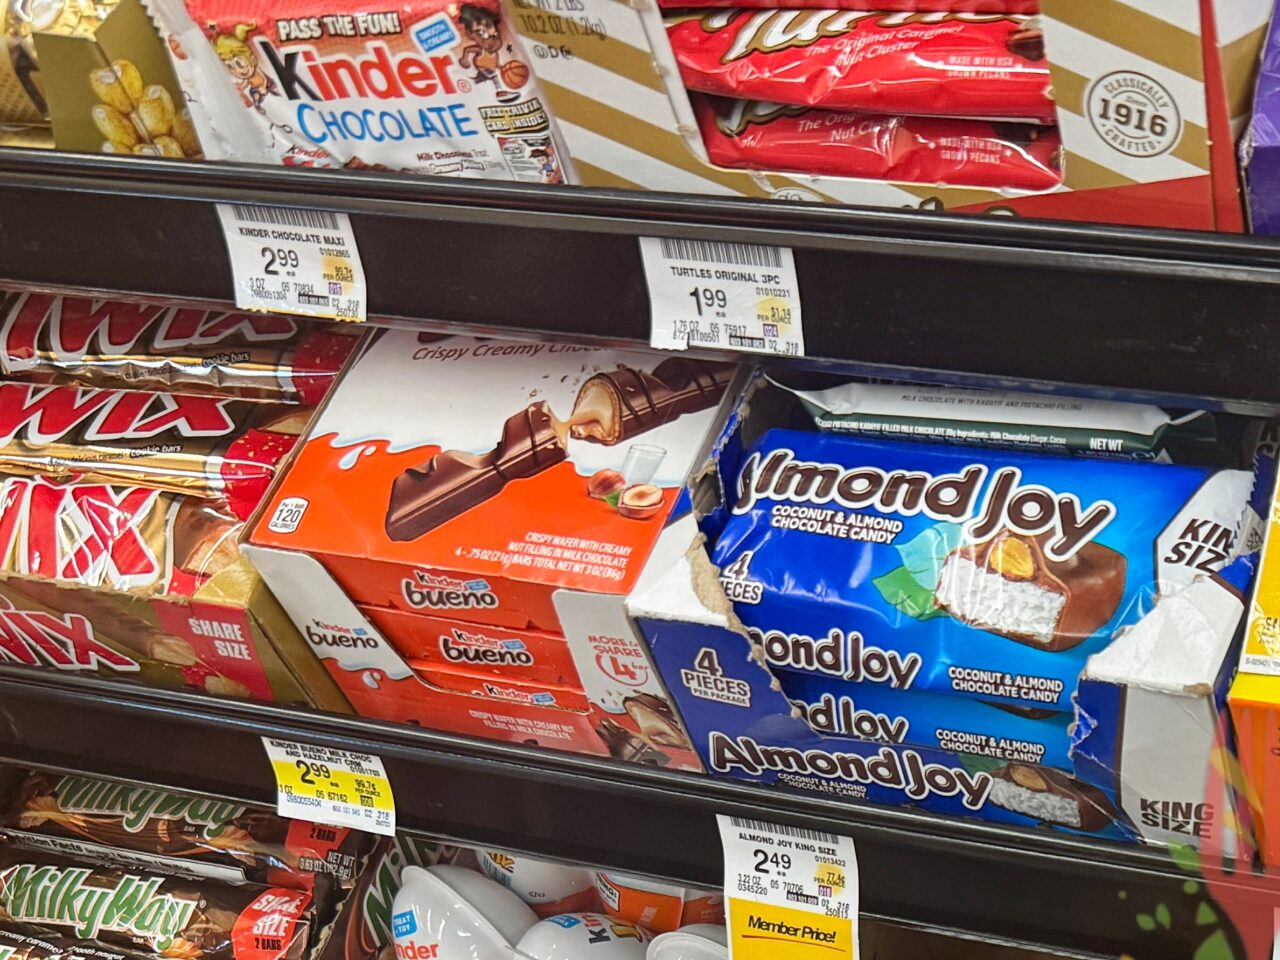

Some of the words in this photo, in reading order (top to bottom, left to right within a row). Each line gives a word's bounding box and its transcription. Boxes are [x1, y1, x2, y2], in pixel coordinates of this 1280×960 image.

[280, 19, 320, 40] PASS
[322, 16, 353, 36] THE
[355, 12, 401, 35] FUN!
[834, 31, 895, 51] Original
[259, 40, 459, 101] Kinder
[297, 103, 478, 144] CHOCOLATE
[1099, 98, 1168, 137] 1916
[239, 227, 271, 238] KINDER
[272, 231, 321, 243] CHOCOLATE
[324, 236, 345, 246] MAXI
[670, 266, 712, 279] TURTLES
[715, 270, 759, 283] ORIGINAL
[762, 275, 781, 284] 3PC
[276, 508, 302, 524] 120
[772, 504, 835, 522] COCONUT
[837, 512, 845, 522] &
[848, 512, 902, 533] ALMOND
[969, 465, 1116, 560] Joy
[526, 532, 553, 543] CRISPY
[553, 535, 580, 547] WAFER
[581, 538, 600, 550] WITH
[600, 541, 632, 555] CREAMY
[771, 515, 848, 538] CHOCOLATE
[850, 524, 896, 544] CANDY
[416, 570, 465, 590] Kinder
[403, 581, 499, 609] bueno
[188, 617, 244, 642] SHARE
[214, 639, 252, 661] SIZE
[695, 649, 721, 677] 4
[681, 672, 750, 698] PIECES
[711, 733, 898, 787] Almond
[904, 747, 994, 809] Joy
[738, 832, 774, 846] ALMOND
[777, 838, 793, 849] JOY
[794, 842, 816, 853] KING
[818, 846, 837, 856] SIZE
[748, 915, 800, 937] Member
[801, 923, 837, 943] Price!
